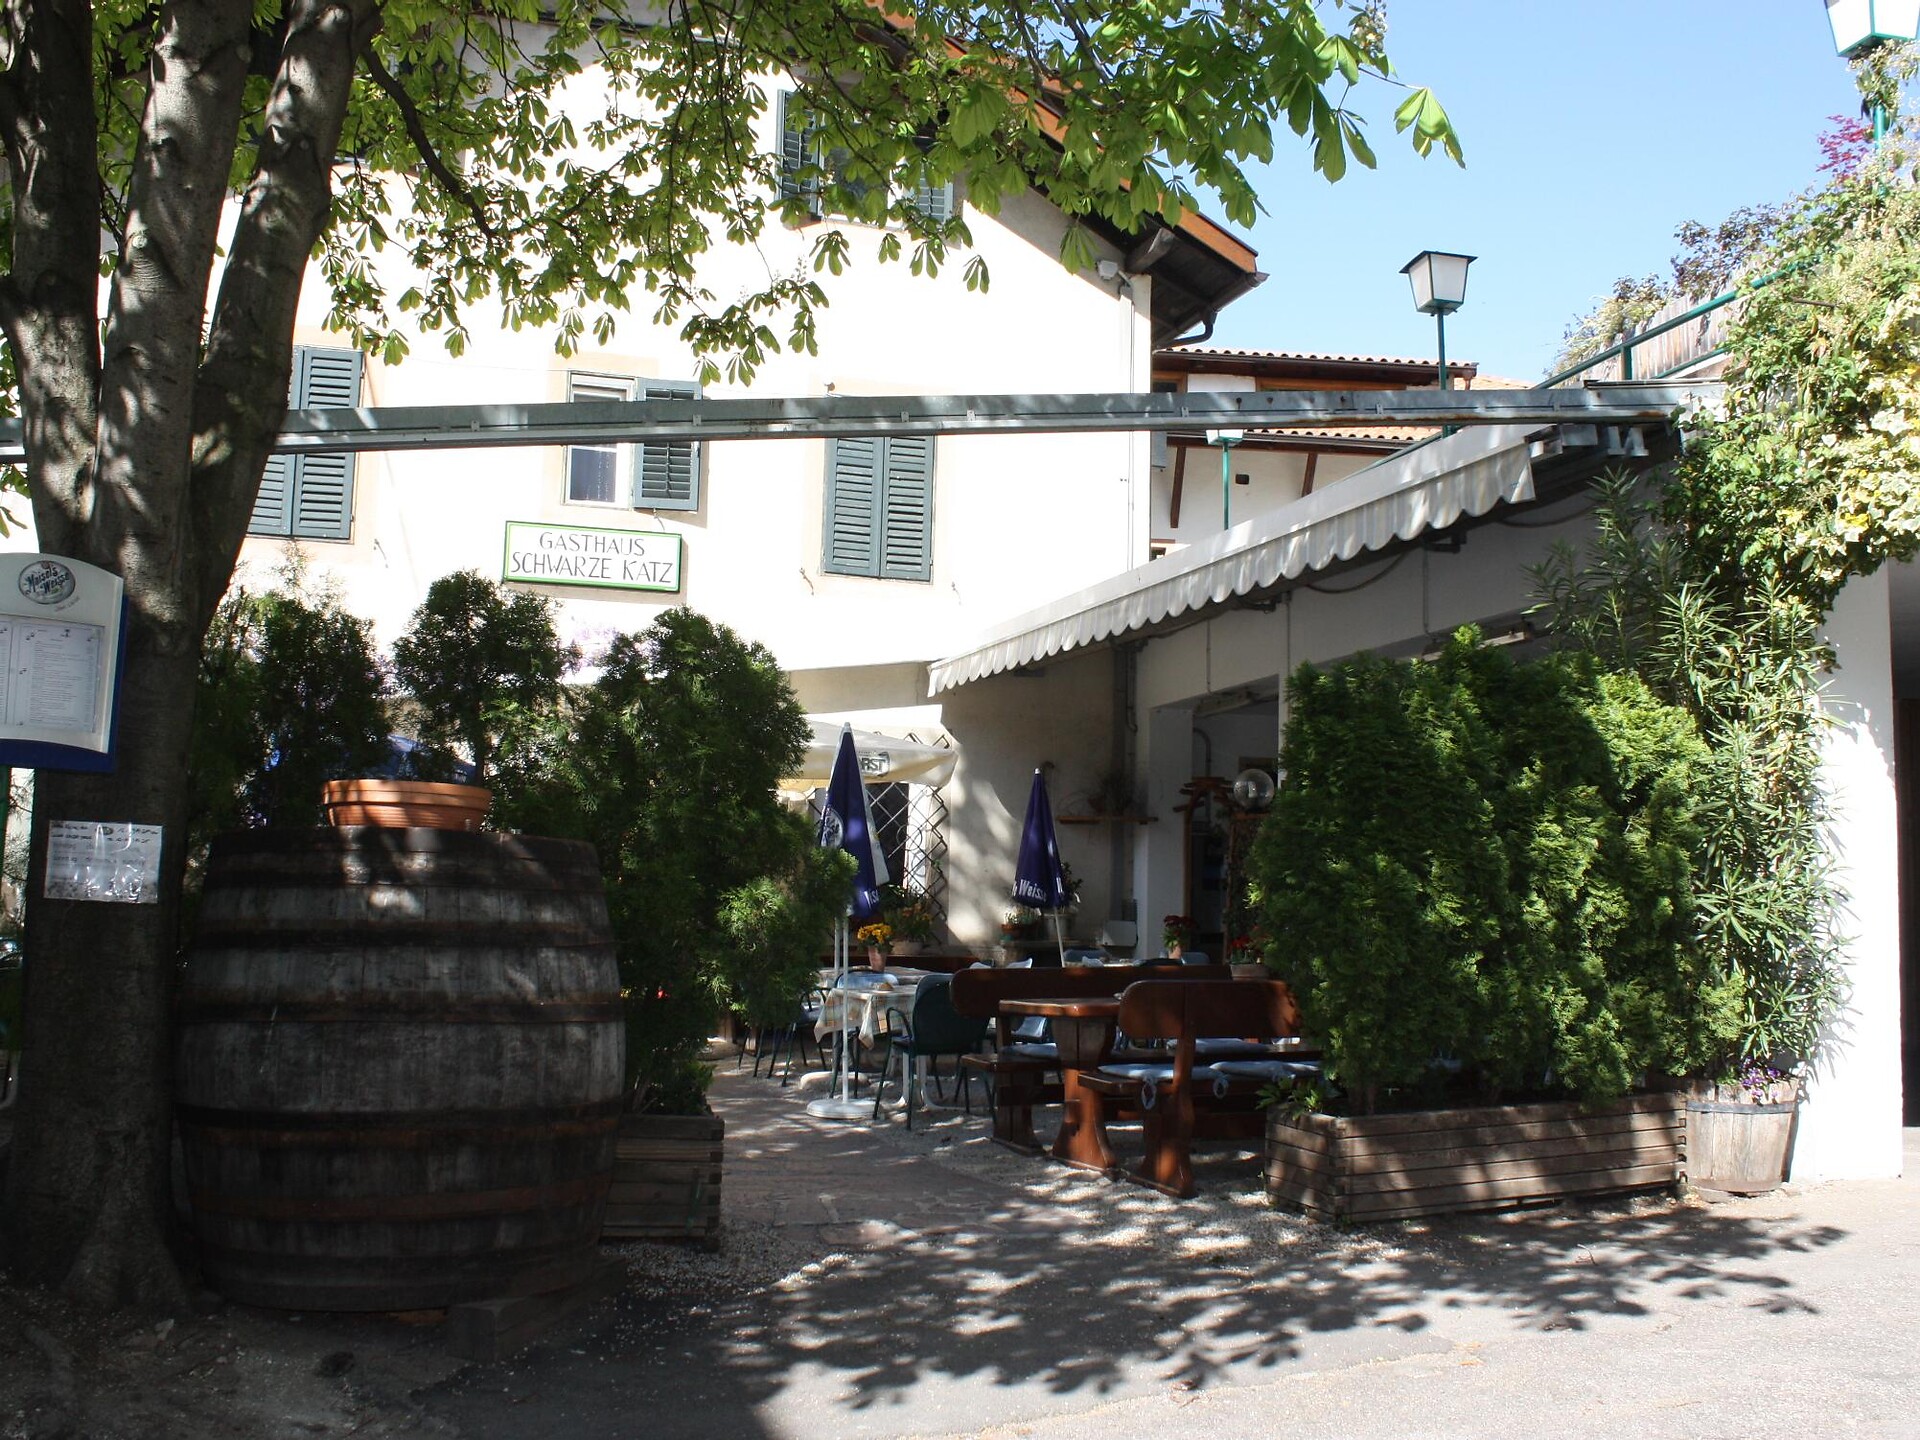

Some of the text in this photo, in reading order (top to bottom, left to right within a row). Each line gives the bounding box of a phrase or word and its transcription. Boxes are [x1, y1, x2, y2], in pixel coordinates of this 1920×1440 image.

[539, 531, 645, 557] GASTHAUS
[511, 551, 673, 583] SCHWARZE KATZ
[859, 757, 886, 772] RST
